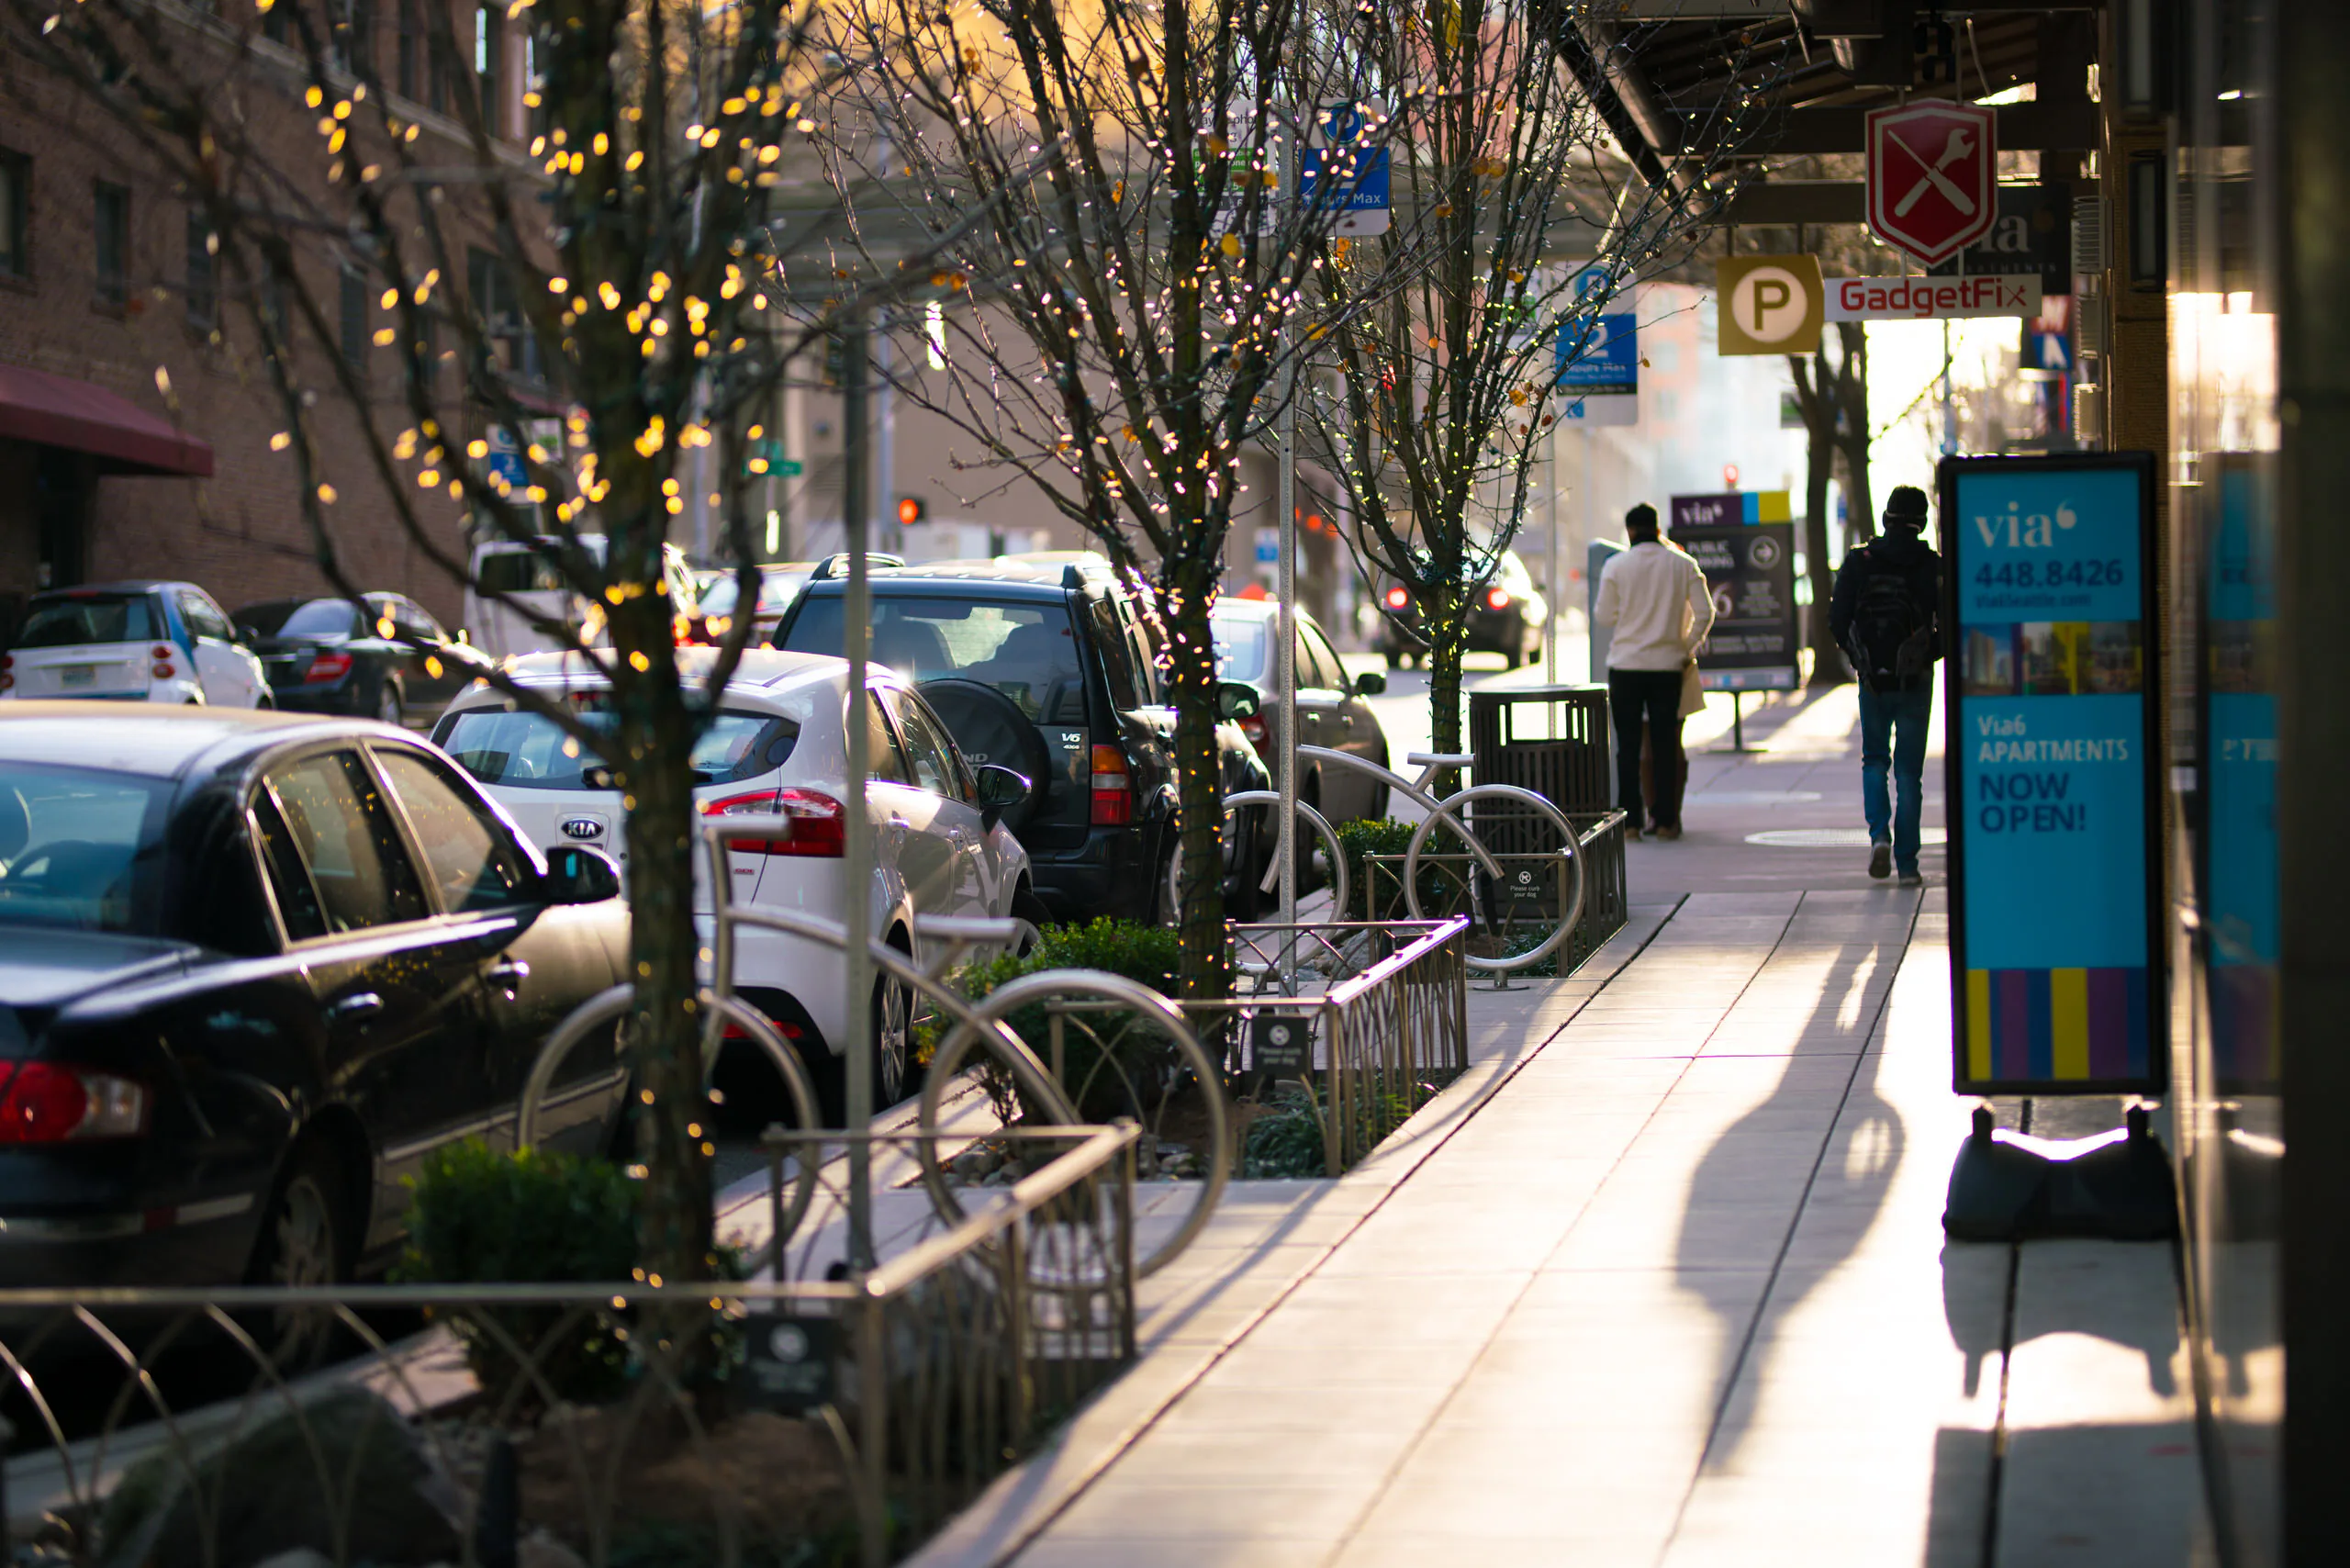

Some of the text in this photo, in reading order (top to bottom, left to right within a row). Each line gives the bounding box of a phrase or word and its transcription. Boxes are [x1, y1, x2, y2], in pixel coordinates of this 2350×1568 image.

[1353, 193, 1382, 204] Max
[1754, 280, 1791, 331] P
[1840, 276, 2028, 318] GadgetFix
[1975, 558, 2124, 588] 448.8426
[1061, 733, 1081, 743] V6
[1978, 714, 2027, 736] Via6
[1978, 738, 2129, 763] APARTMENTS
[1980, 771, 2070, 801] NOW
[566, 822, 597, 836] KIA
[1980, 803, 2087, 834] OPEN!
